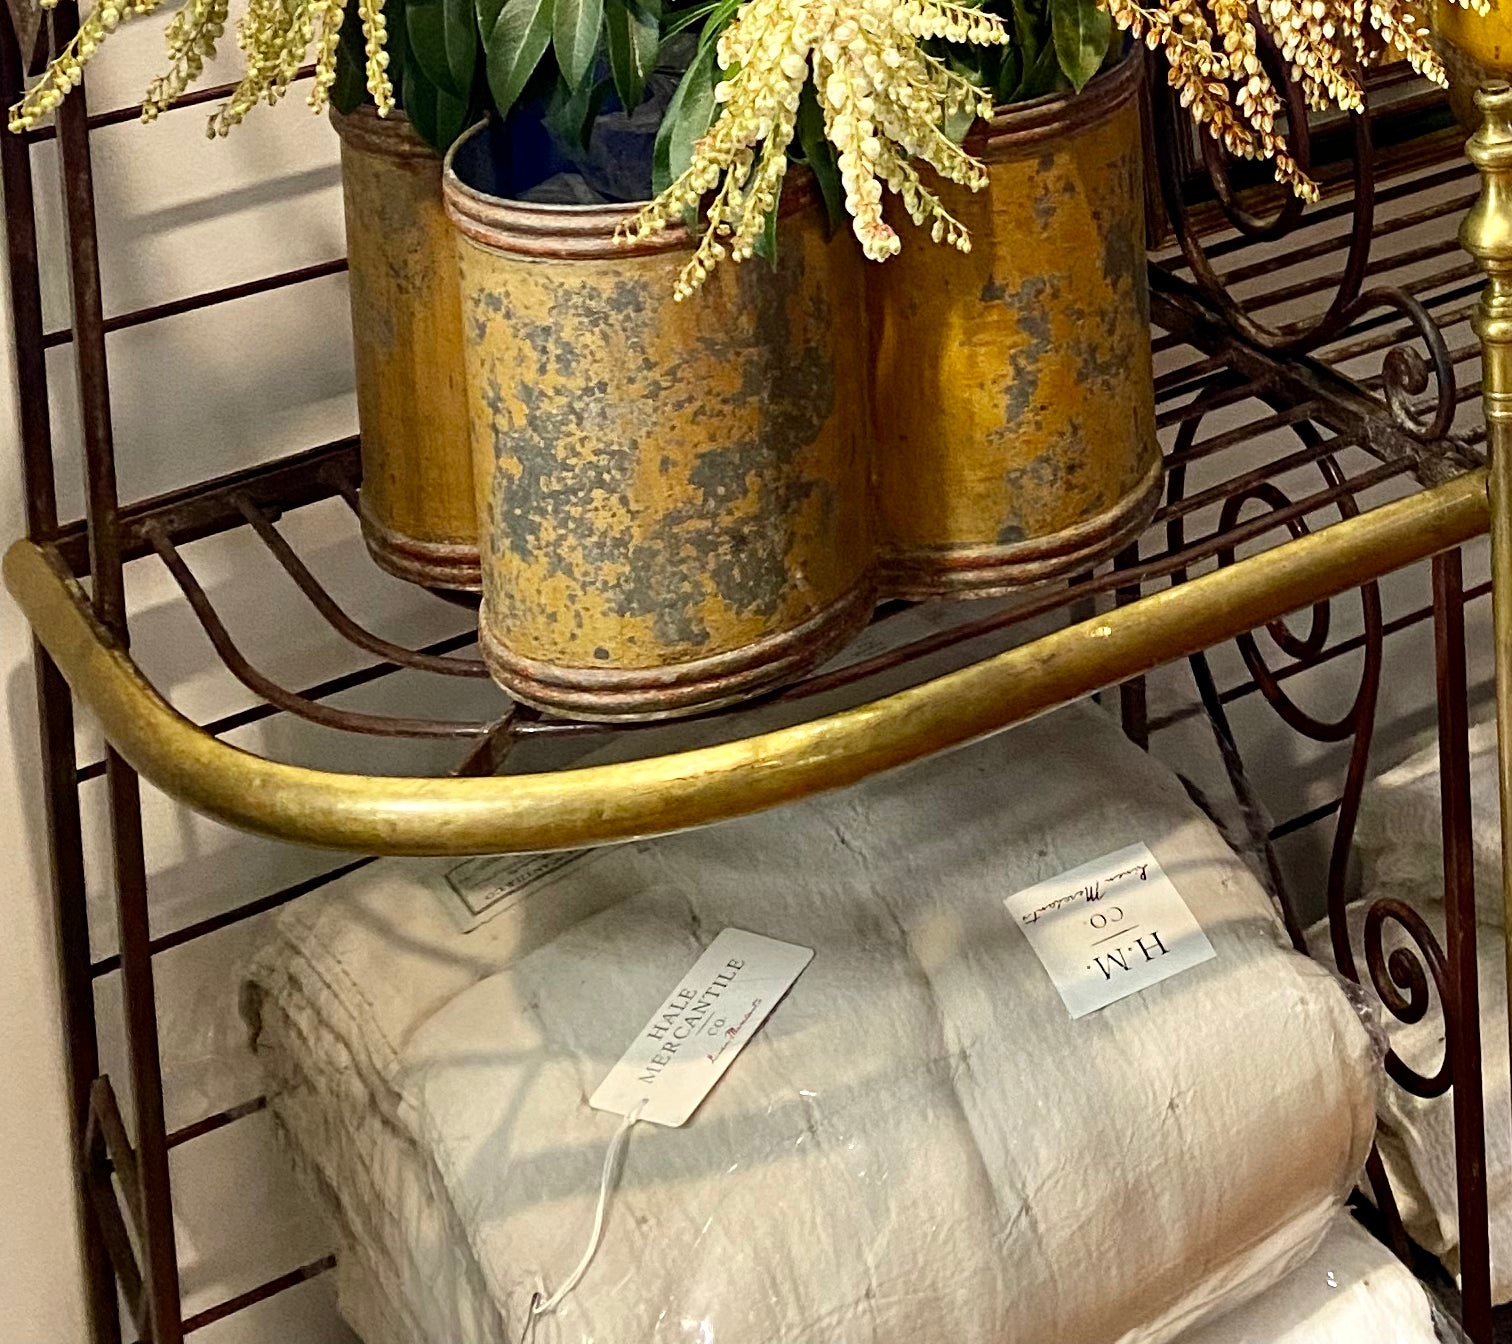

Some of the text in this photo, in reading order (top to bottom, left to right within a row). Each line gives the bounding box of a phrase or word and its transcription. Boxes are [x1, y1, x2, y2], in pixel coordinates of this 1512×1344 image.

[1087, 931, 1170, 980] H.M.
[638, 959, 745, 1084] MERCANTILE
[647, 988, 698, 1040] HALE
